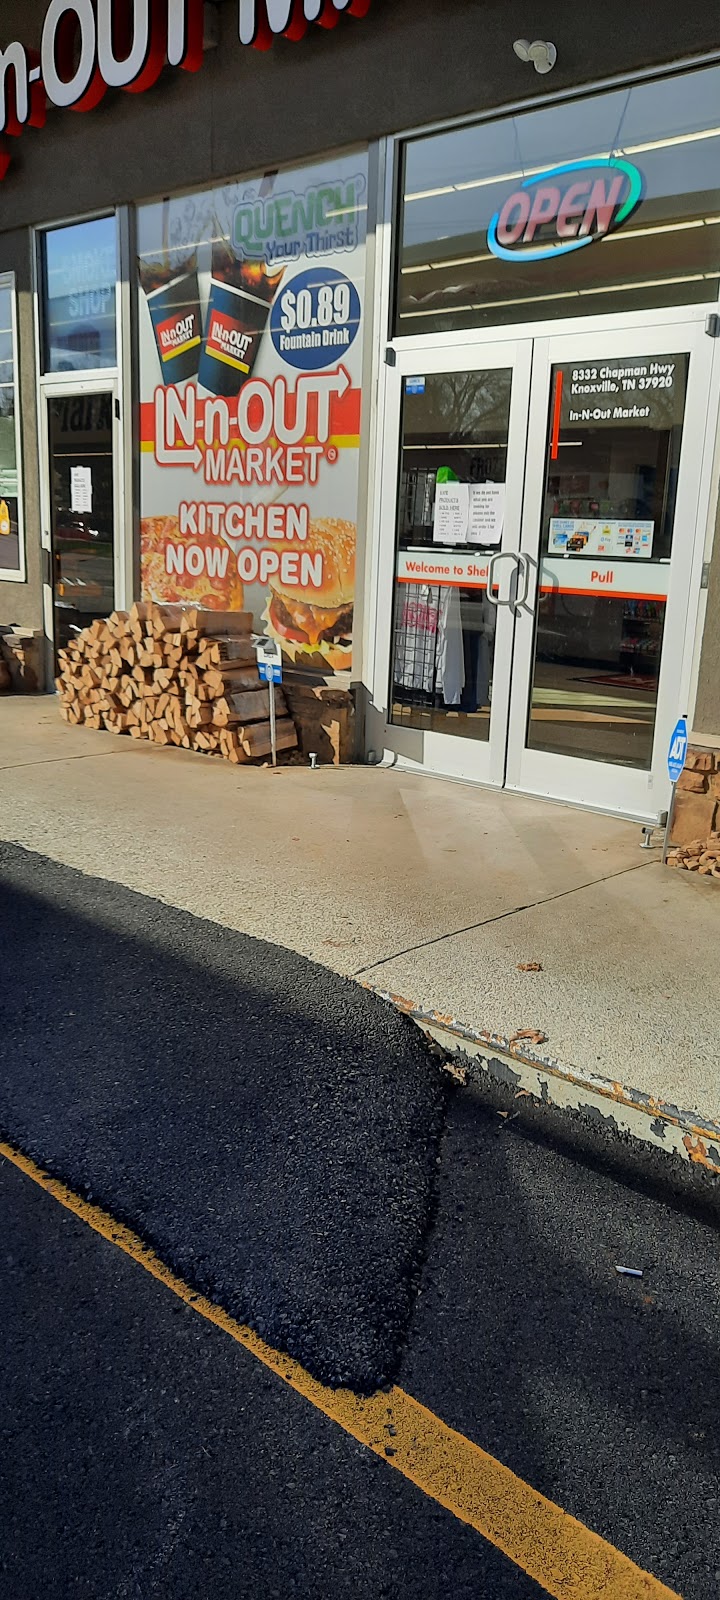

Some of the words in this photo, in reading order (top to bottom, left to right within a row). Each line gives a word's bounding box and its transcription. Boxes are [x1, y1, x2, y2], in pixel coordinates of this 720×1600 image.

[235, 182, 355, 252] QUENCH
[497, 175, 623, 246] OPEN
[266, 241, 300, 260] Your
[306, 227, 354, 252] Thirst
[280, 283, 350, 334] $0.89
[220, 342, 246, 360] MARKET
[280, 331, 321, 351] Fountain
[322, 328, 350, 347] Drink
[571, 380, 619, 395] Knoxville,
[622, 379, 636, 391] TN
[638, 376, 673, 390] 37920
[572, 368, 598, 381] 8332
[600, 366, 647, 380] Chapman
[649, 363, 675, 376] Hwy
[156, 372, 349, 463] IN-n-OUT
[613, 405, 650, 419] Market
[205, 446, 324, 483] MARKET
[180, 503, 309, 541] KITCHEN
[165, 545, 229, 579] NOW
[237, 549, 323, 588] OPEN
[406, 561, 450, 575] Welcome
[453, 565, 464, 575] to
[467, 564, 489, 577] Shel
[591, 571, 613, 583] Pull
